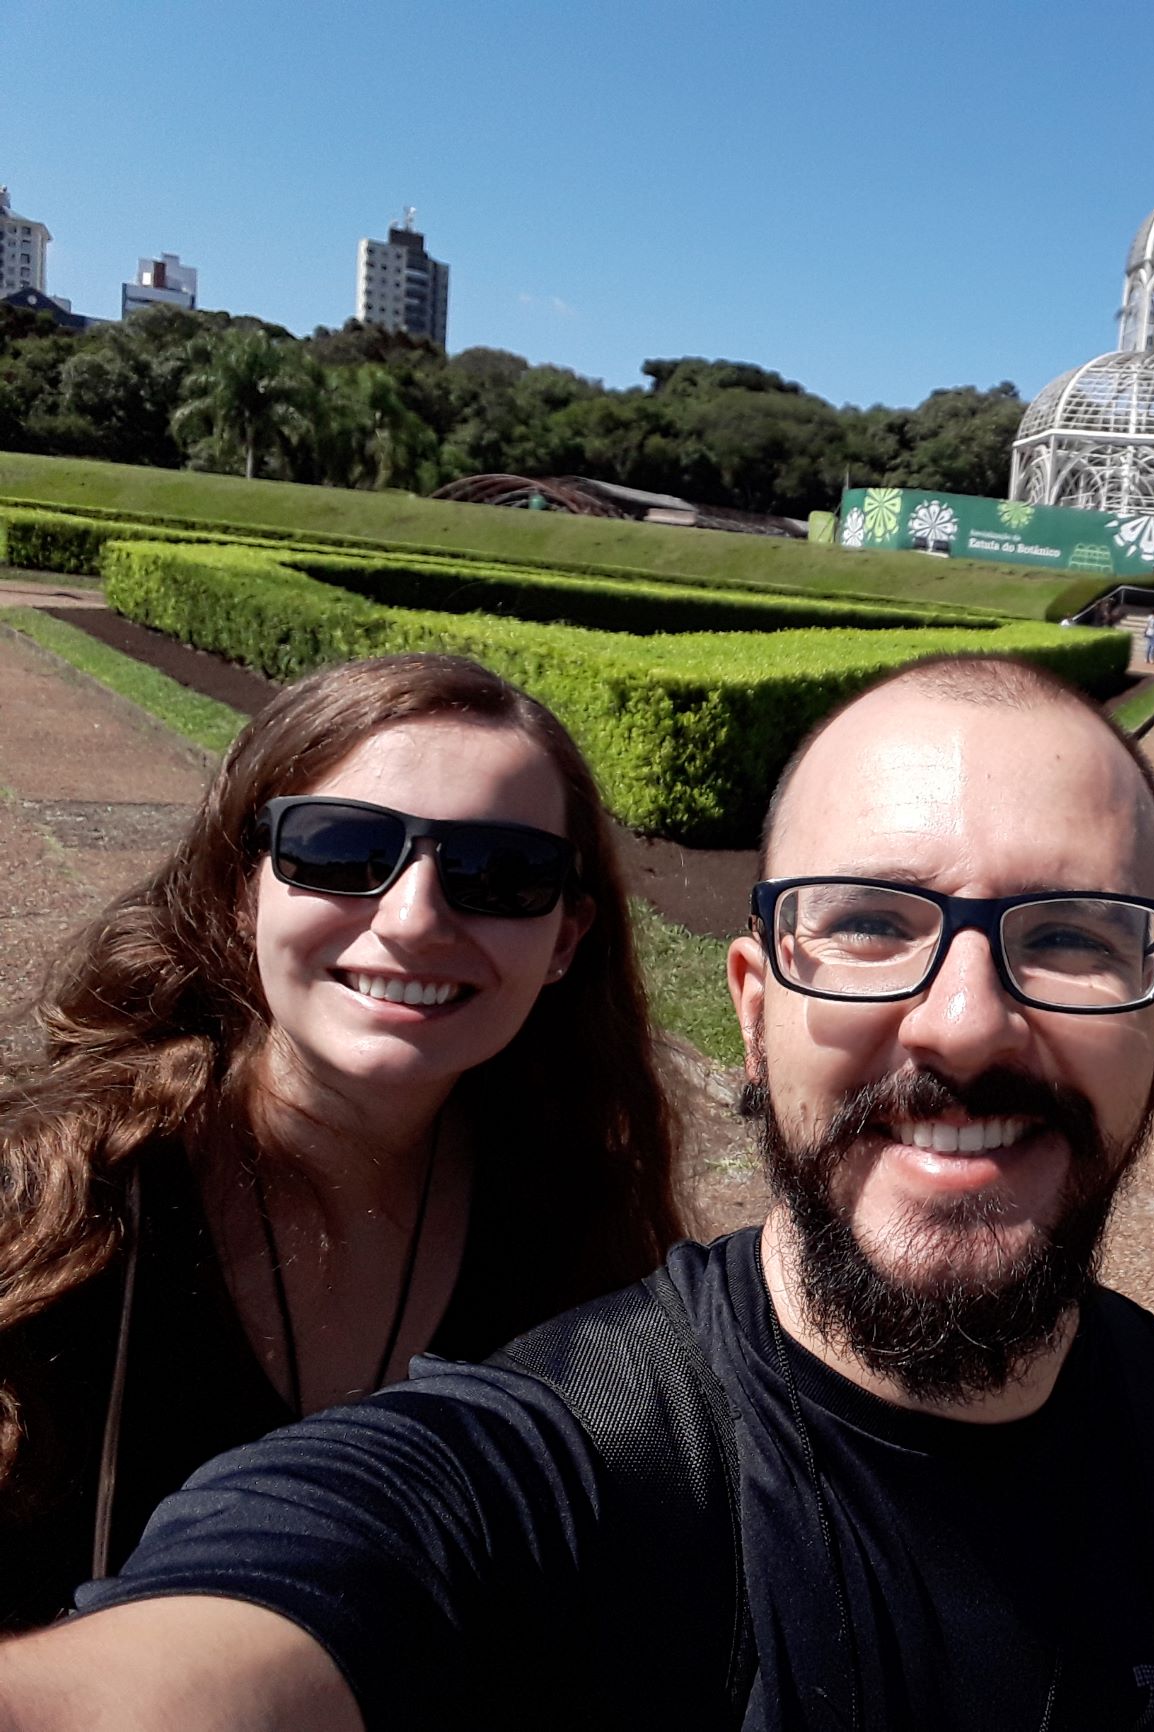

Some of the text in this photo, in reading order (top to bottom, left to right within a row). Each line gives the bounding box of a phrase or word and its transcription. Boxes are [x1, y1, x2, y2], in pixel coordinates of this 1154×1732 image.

[968, 538, 1060, 557] Estufa do Botânico
